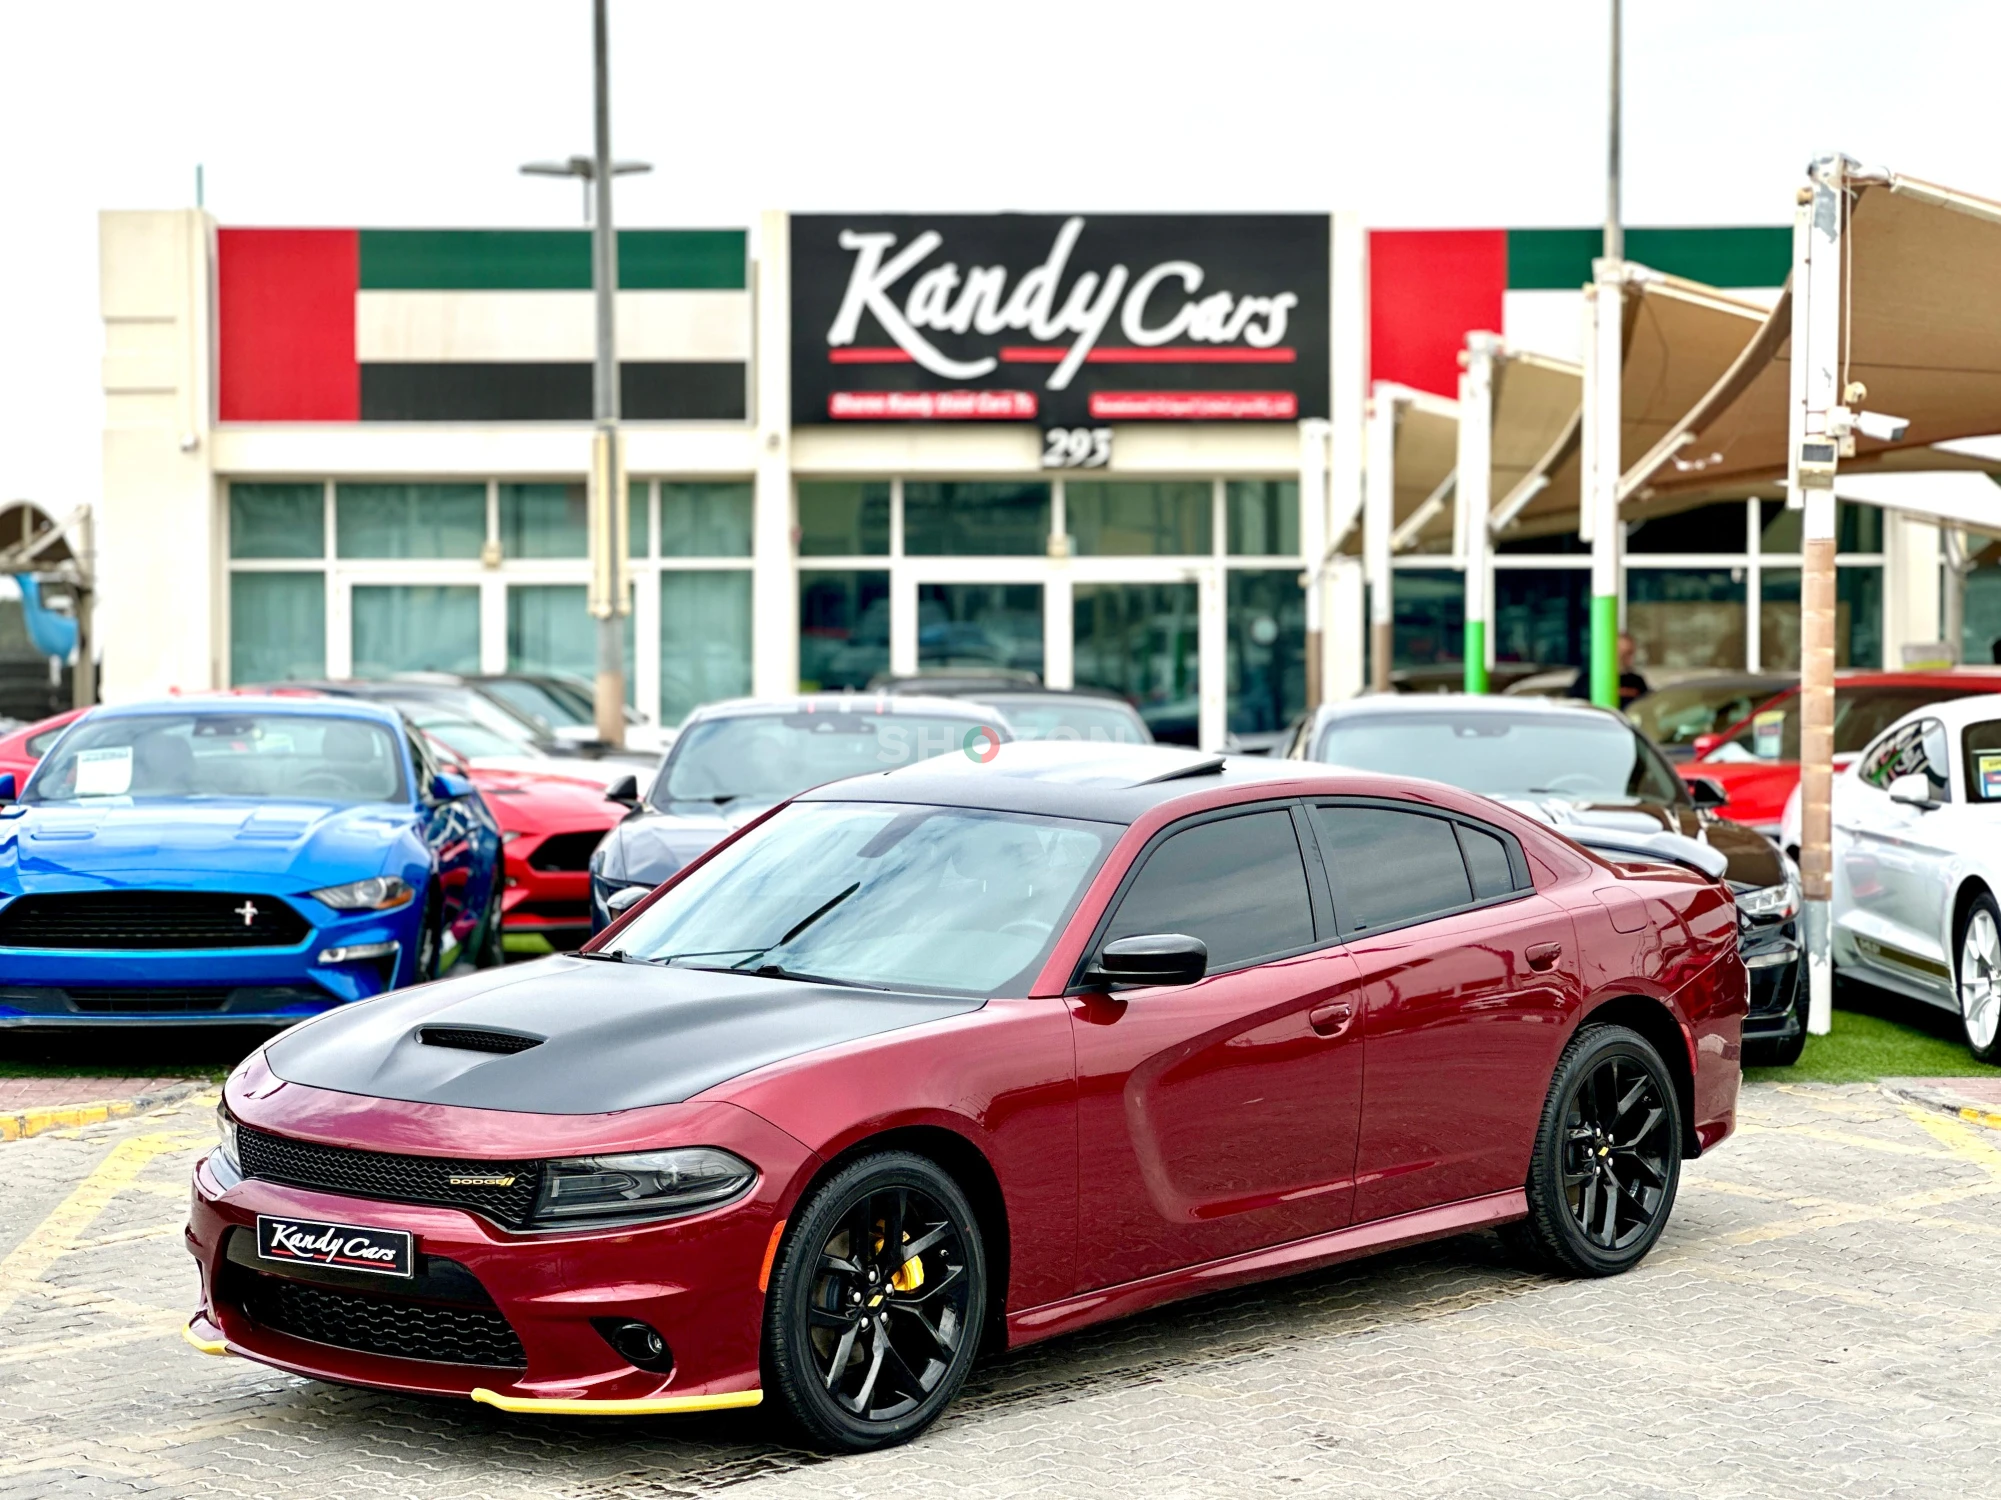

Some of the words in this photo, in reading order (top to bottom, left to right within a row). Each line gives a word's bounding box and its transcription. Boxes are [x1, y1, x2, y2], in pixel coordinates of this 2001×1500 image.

[827, 217, 1129, 390] Kandy
[1121, 260, 1298, 347] Cars
[1041, 426, 1115, 468] 295
[449, 1177, 508, 1186] DODGE
[271, 1223, 344, 1263] Kandy
[343, 1237, 397, 1261] Cars
